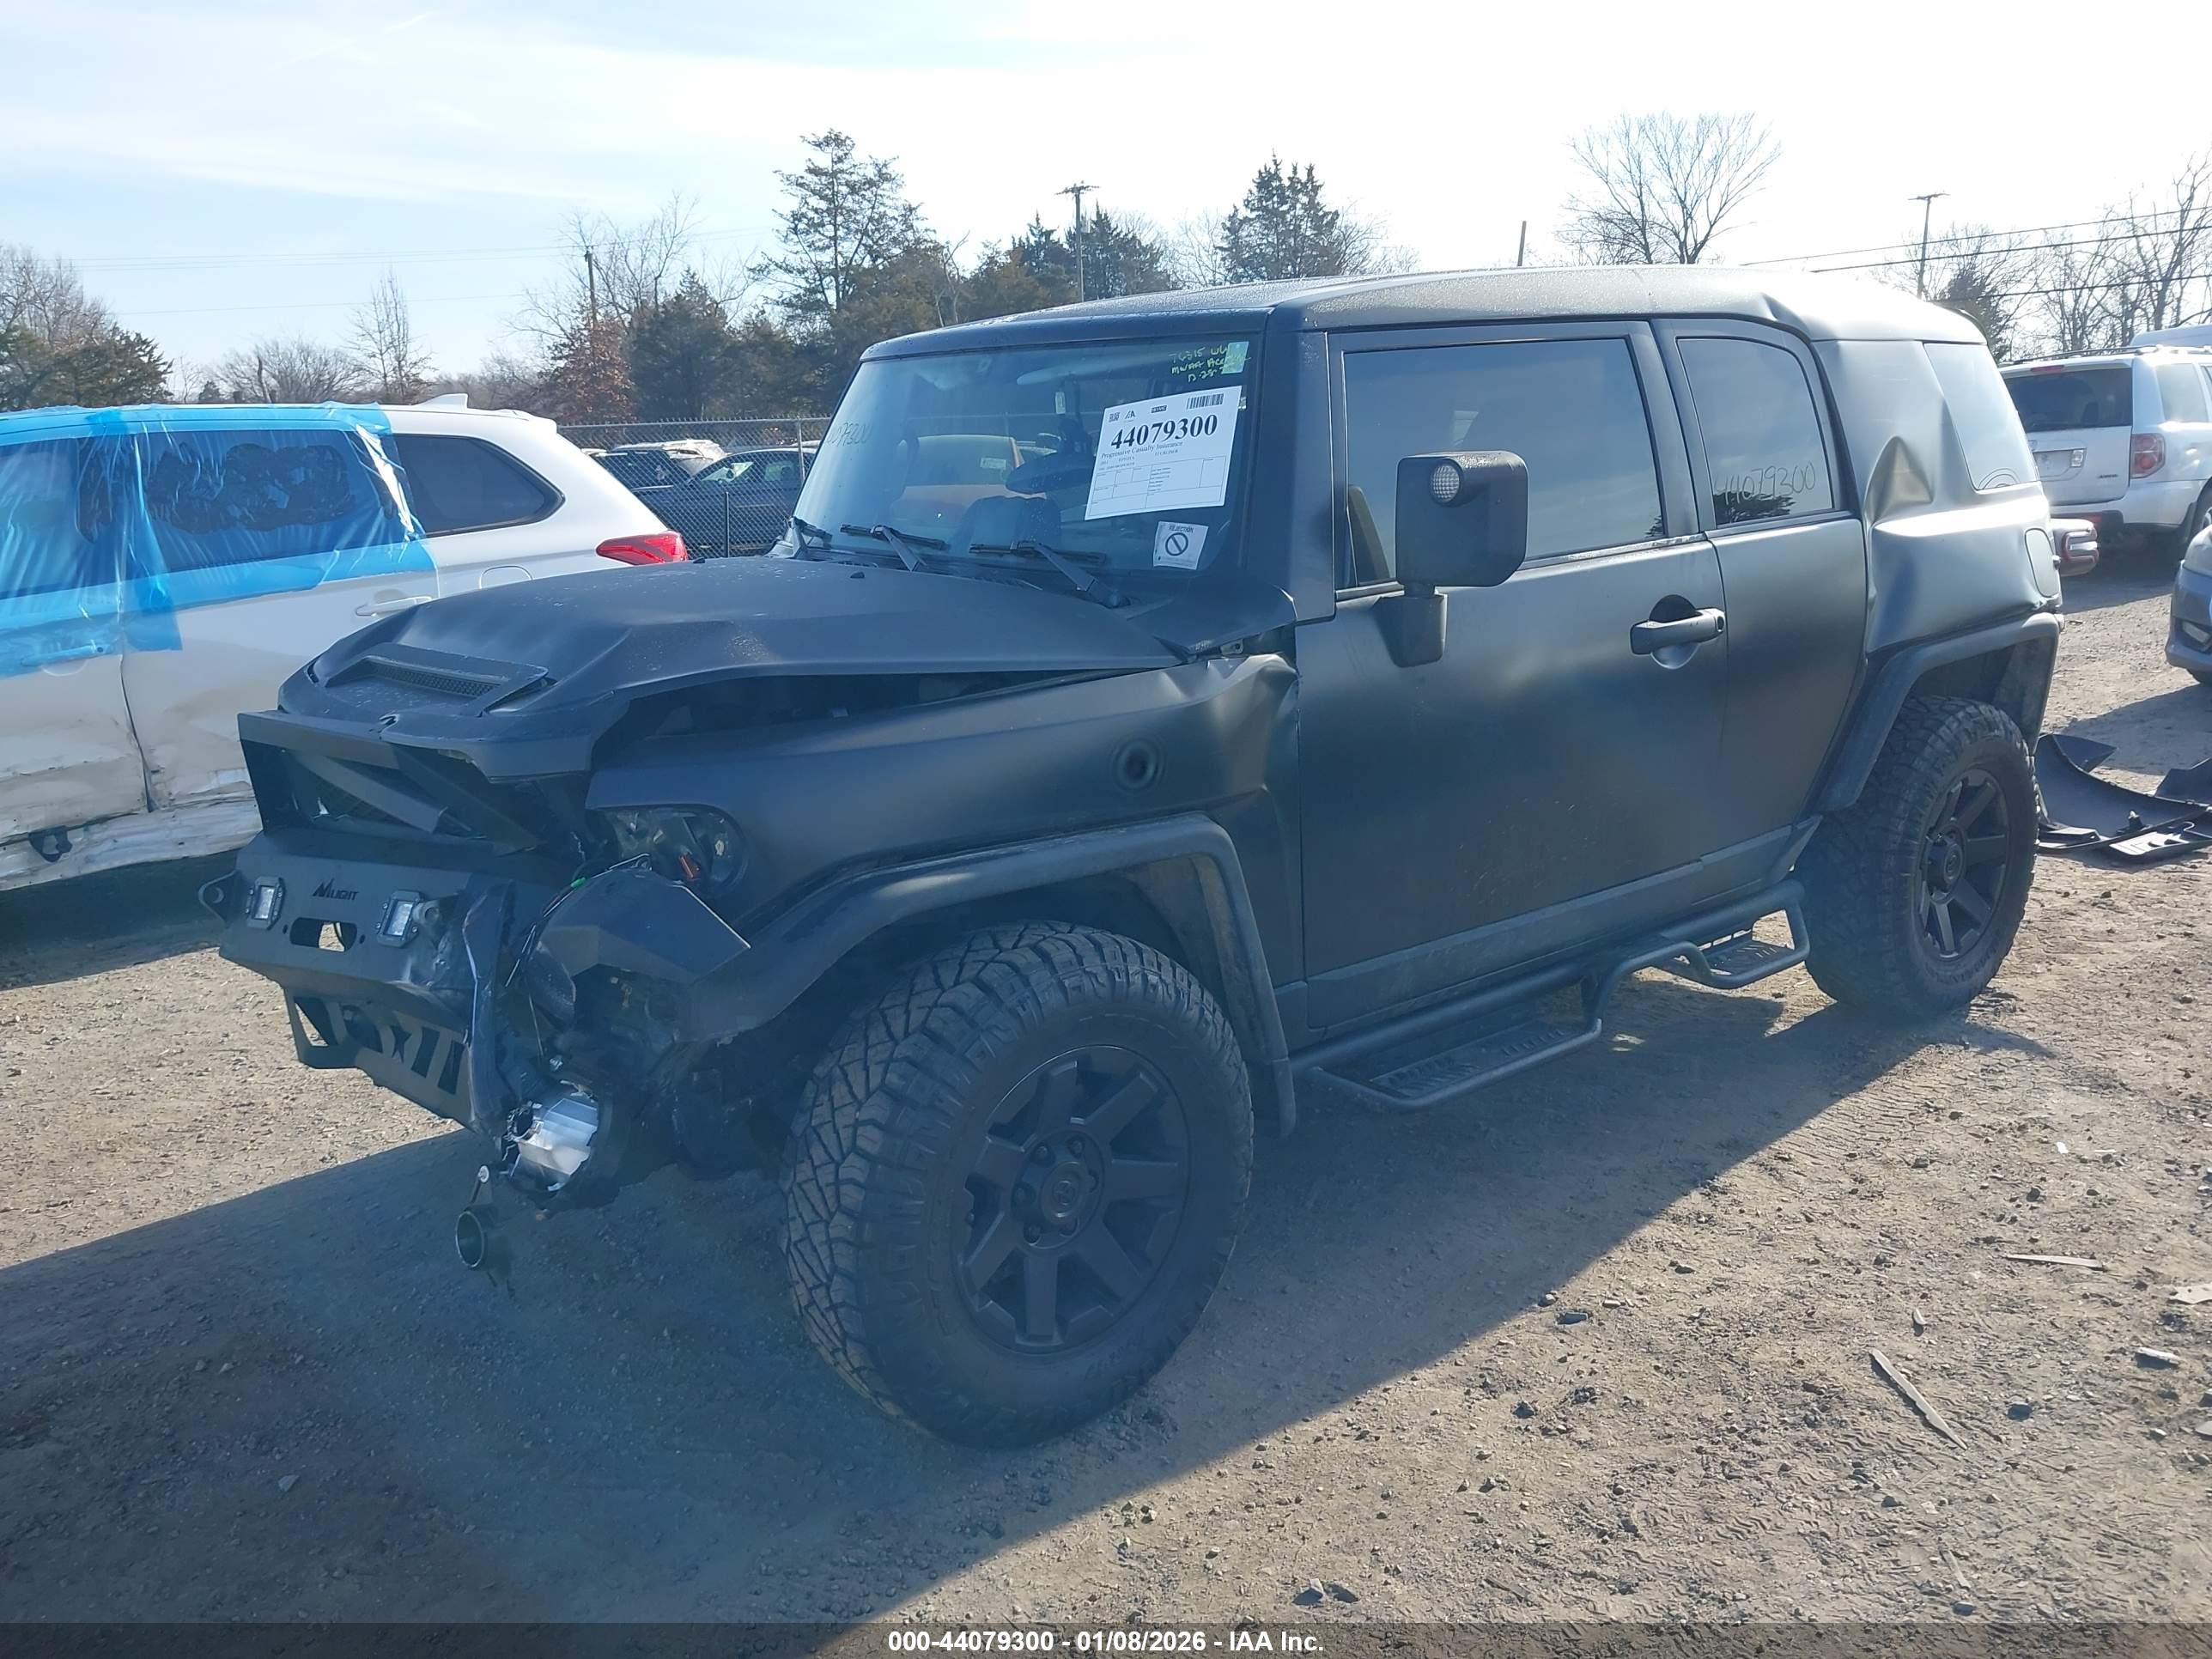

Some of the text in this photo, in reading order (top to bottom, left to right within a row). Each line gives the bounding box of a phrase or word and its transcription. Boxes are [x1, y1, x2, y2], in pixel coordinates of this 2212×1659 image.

[1110, 414, 1218, 449] 44079300
[1101, 448, 1131, 459] Progressive
[1131, 444, 1154, 454] Casualty
[1714, 461, 1816, 505] 44079300
